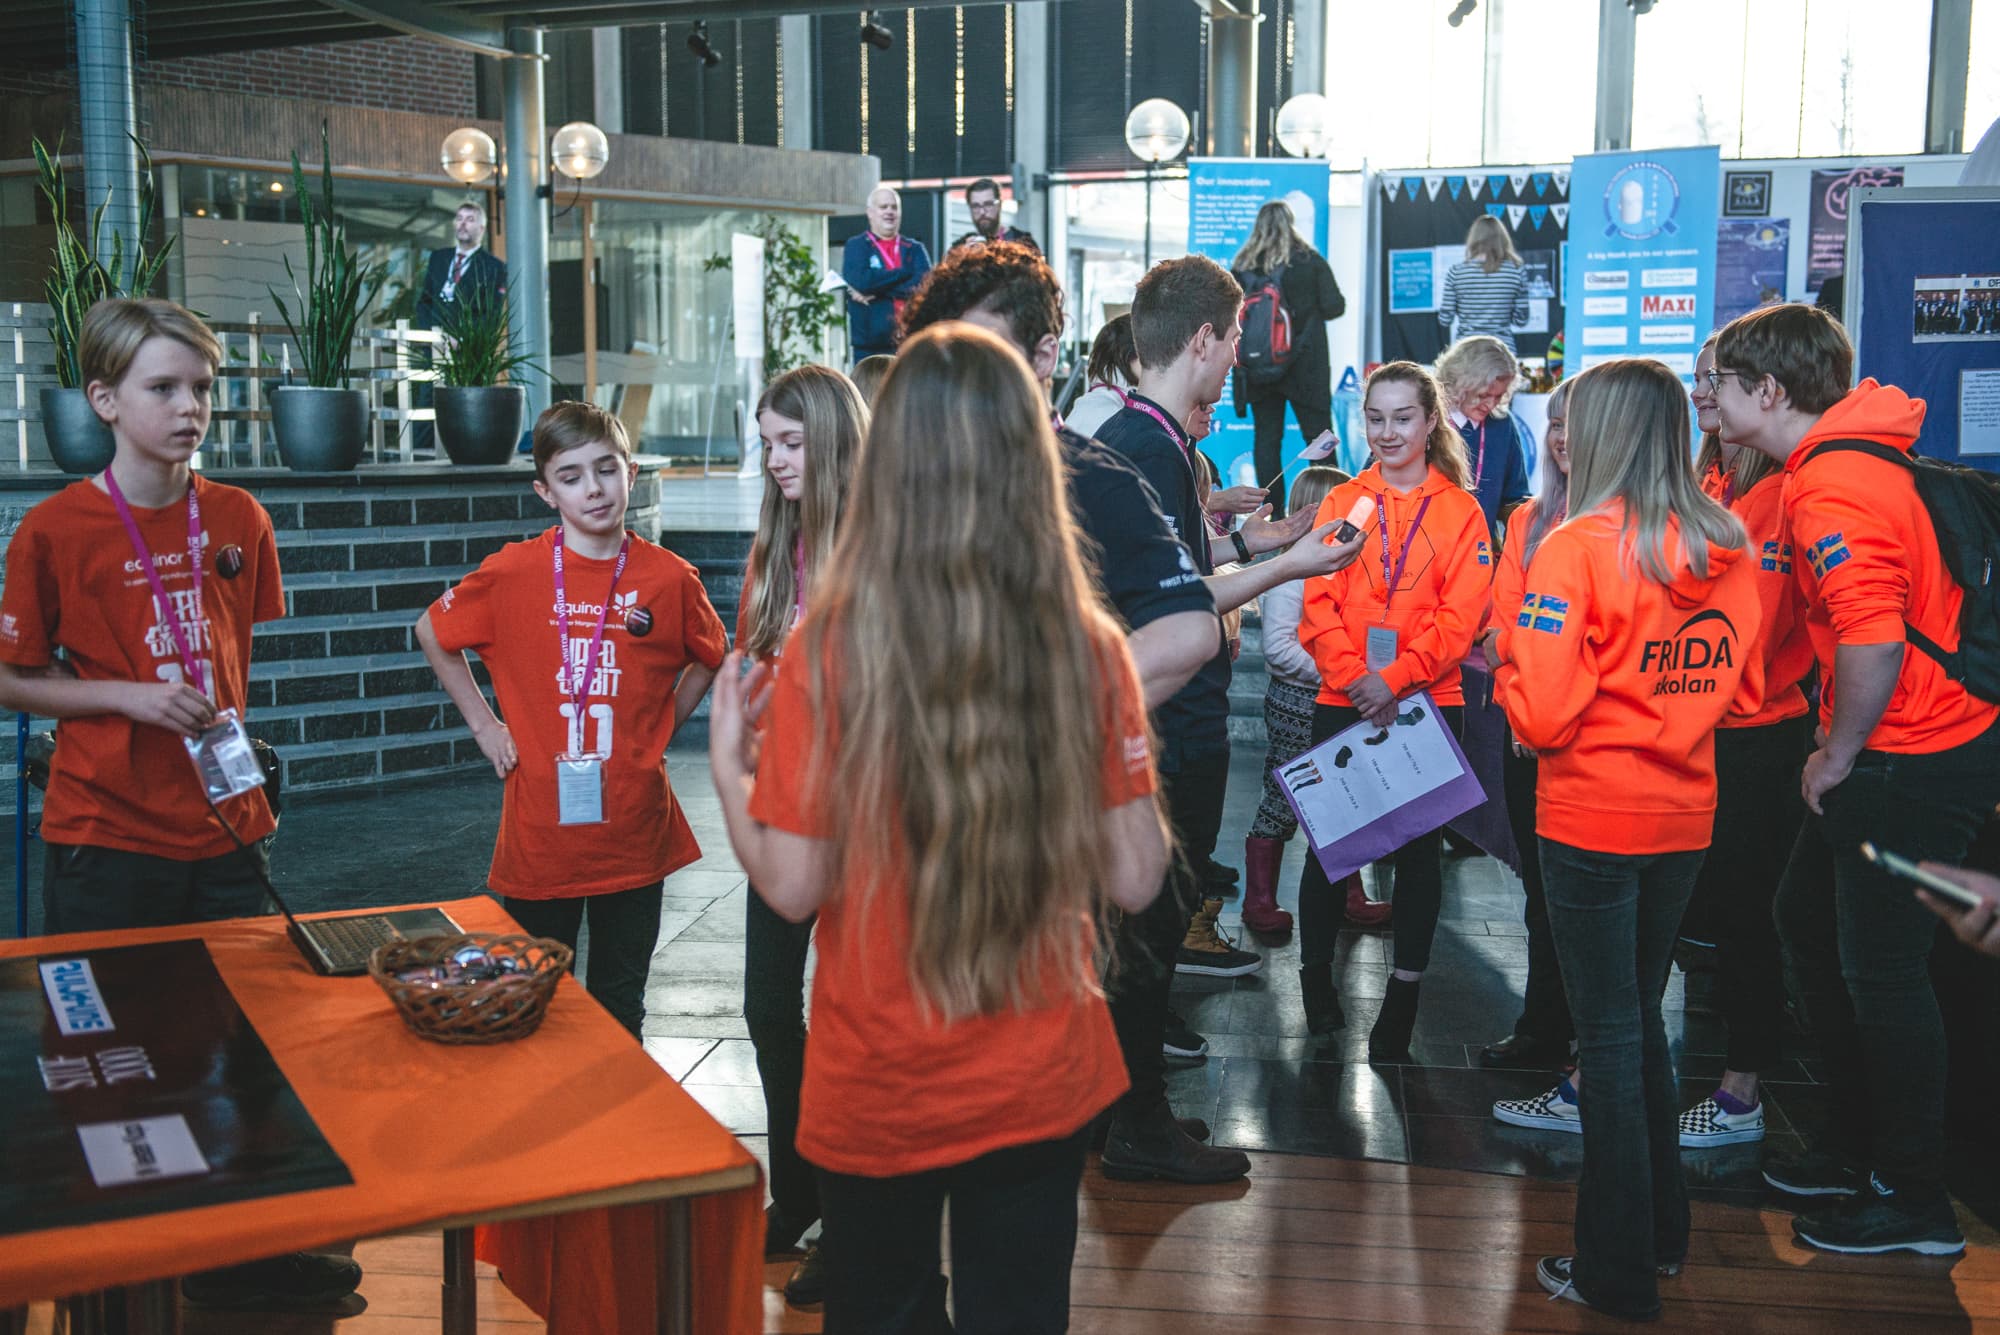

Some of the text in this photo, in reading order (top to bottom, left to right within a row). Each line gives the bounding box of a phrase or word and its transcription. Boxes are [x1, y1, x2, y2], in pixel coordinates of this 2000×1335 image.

[1642, 295, 1694, 313] MAXI
[1162, 418, 1180, 442] VISITOR
[554, 545, 563, 573] VISITOR
[556, 588, 566, 618] VISITOR
[560, 633, 570, 663] VISITOR
[1639, 636, 1733, 672] FRIDA
[1653, 673, 1716, 696] skolan
